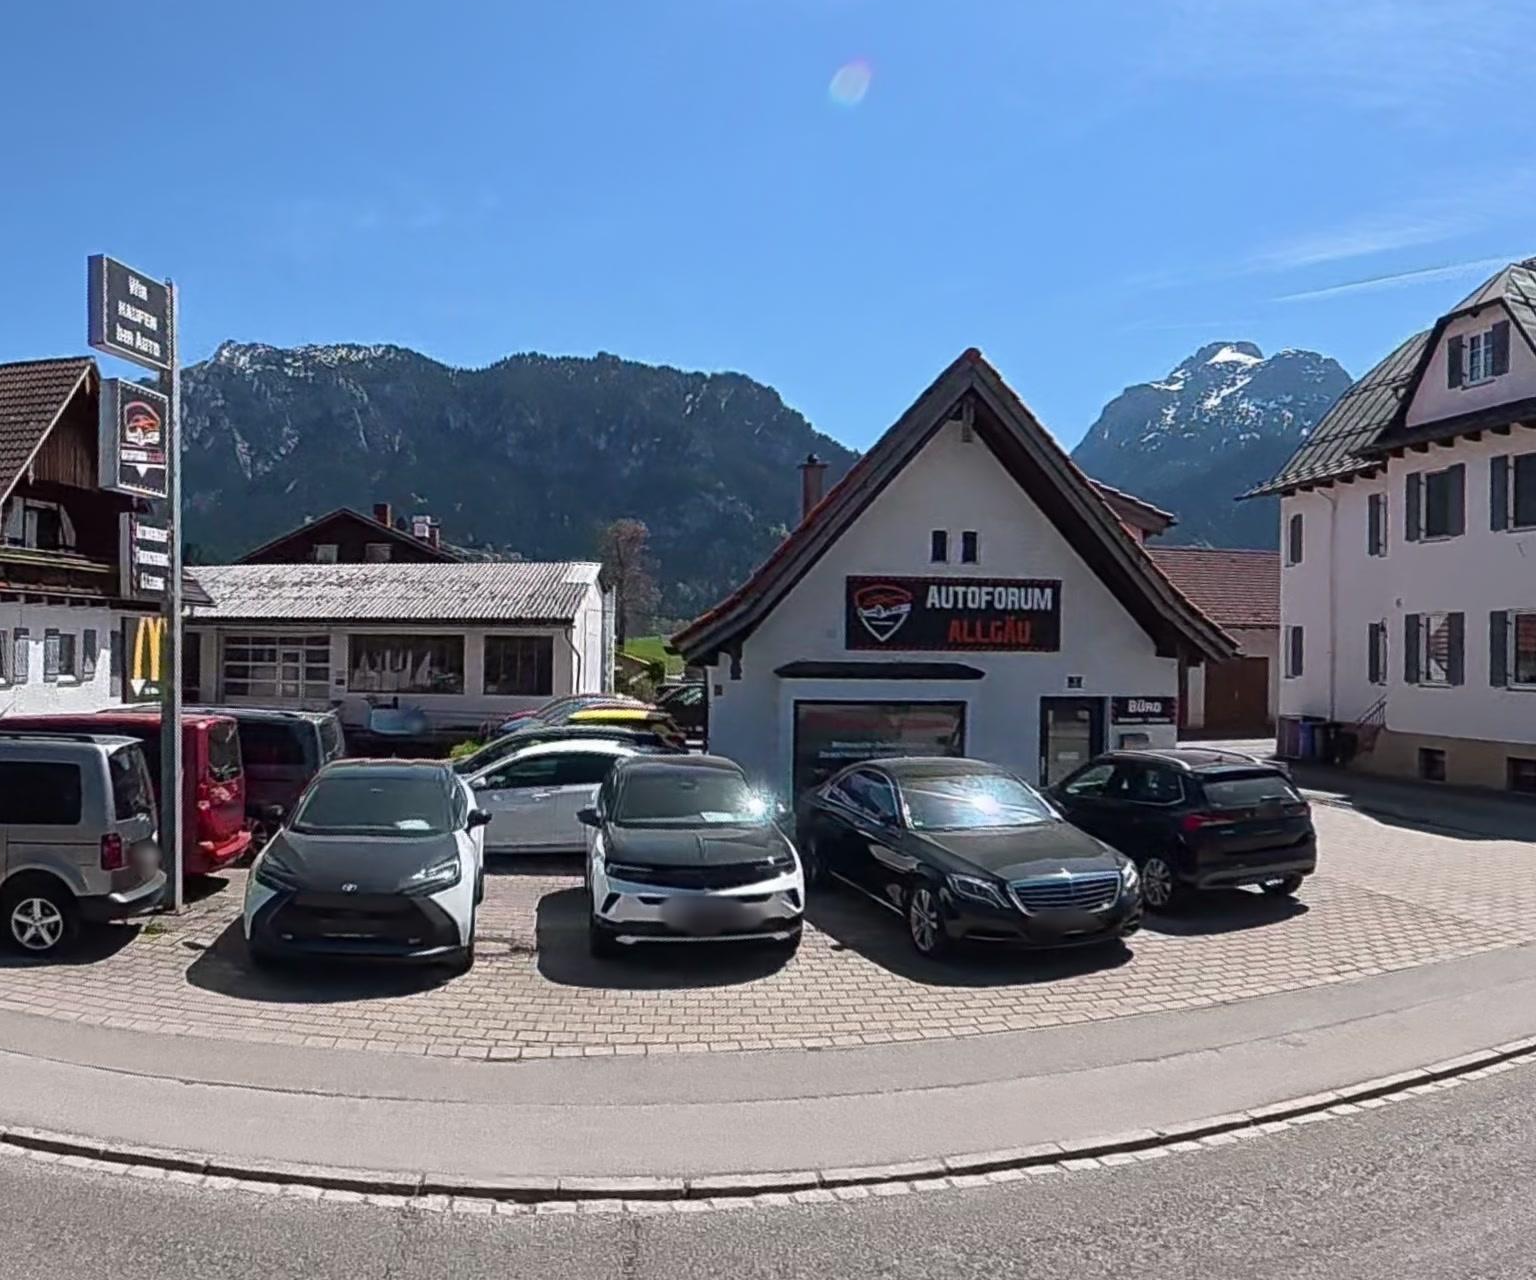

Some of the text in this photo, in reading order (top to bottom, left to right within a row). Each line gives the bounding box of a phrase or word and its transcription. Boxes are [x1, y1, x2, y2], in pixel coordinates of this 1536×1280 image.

[925, 584, 1053, 611] AUTOFORUM
[948, 616, 1032, 644] ALLGÄU
[1128, 699, 1163, 713] BÜRO
